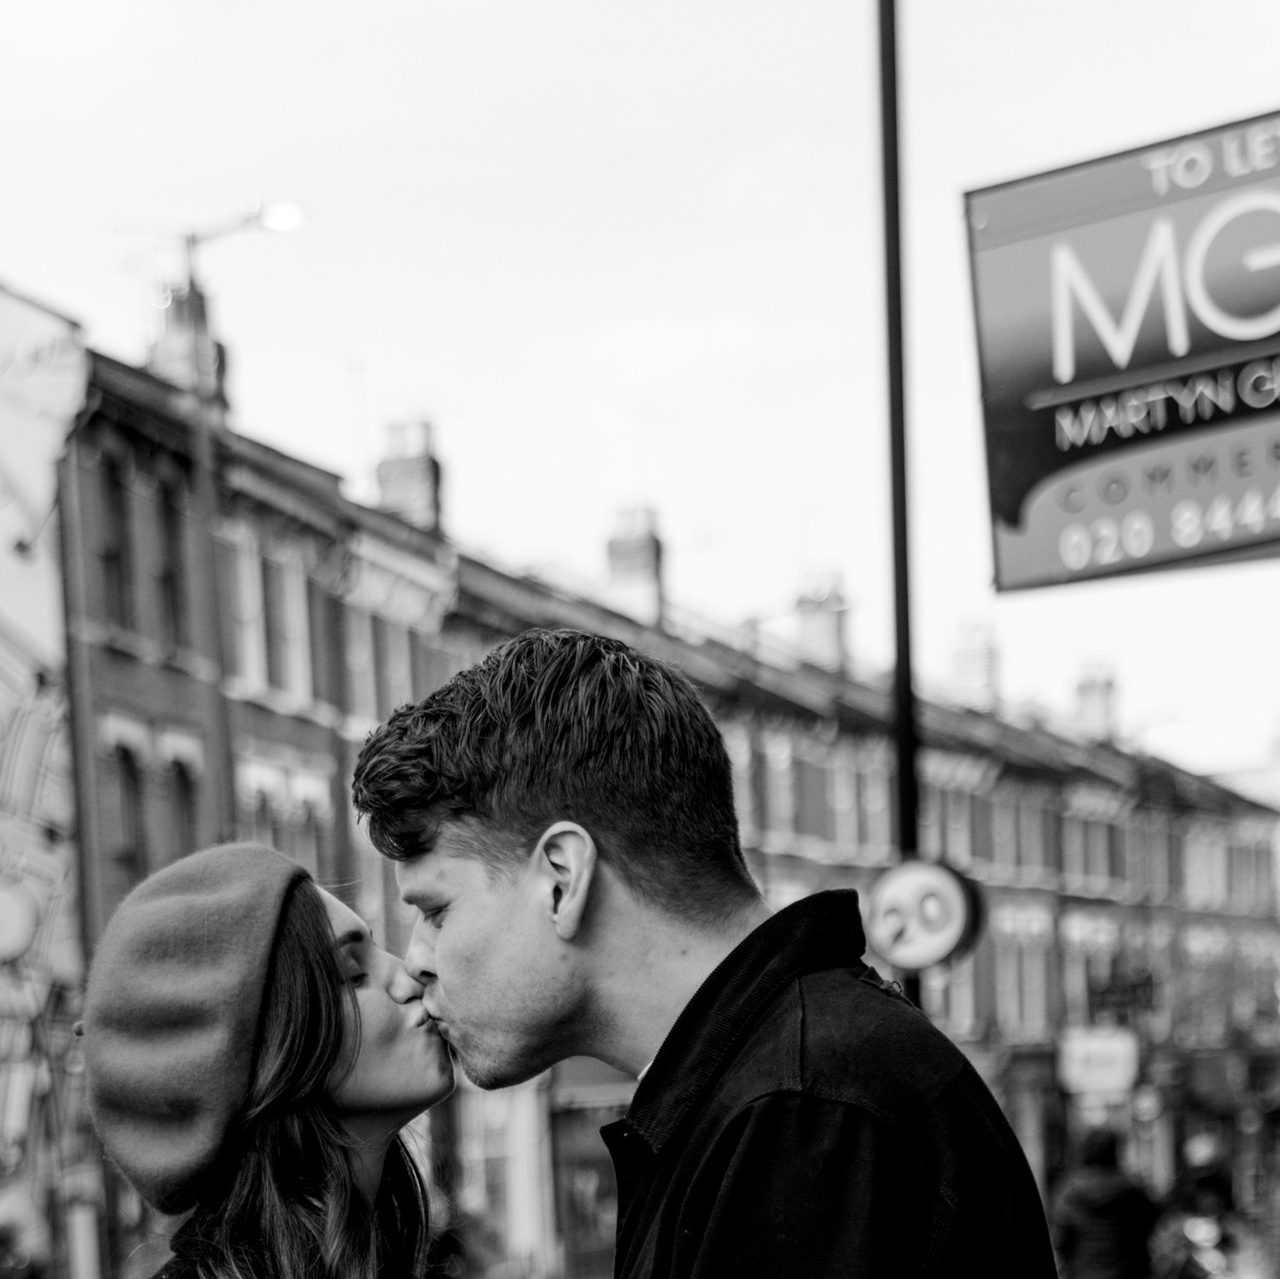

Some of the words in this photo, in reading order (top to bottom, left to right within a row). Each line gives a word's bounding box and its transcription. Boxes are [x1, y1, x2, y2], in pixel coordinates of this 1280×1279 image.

[1141, 141, 1213, 195] TO
[1222, 122, 1280, 177] LE
[1048, 187, 1280, 384] MG
[1055, 371, 1236, 452] MARTYN
[1237, 358, 1280, 409] G
[1058, 511, 1155, 571] 020
[881, 884, 952, 947] 20
